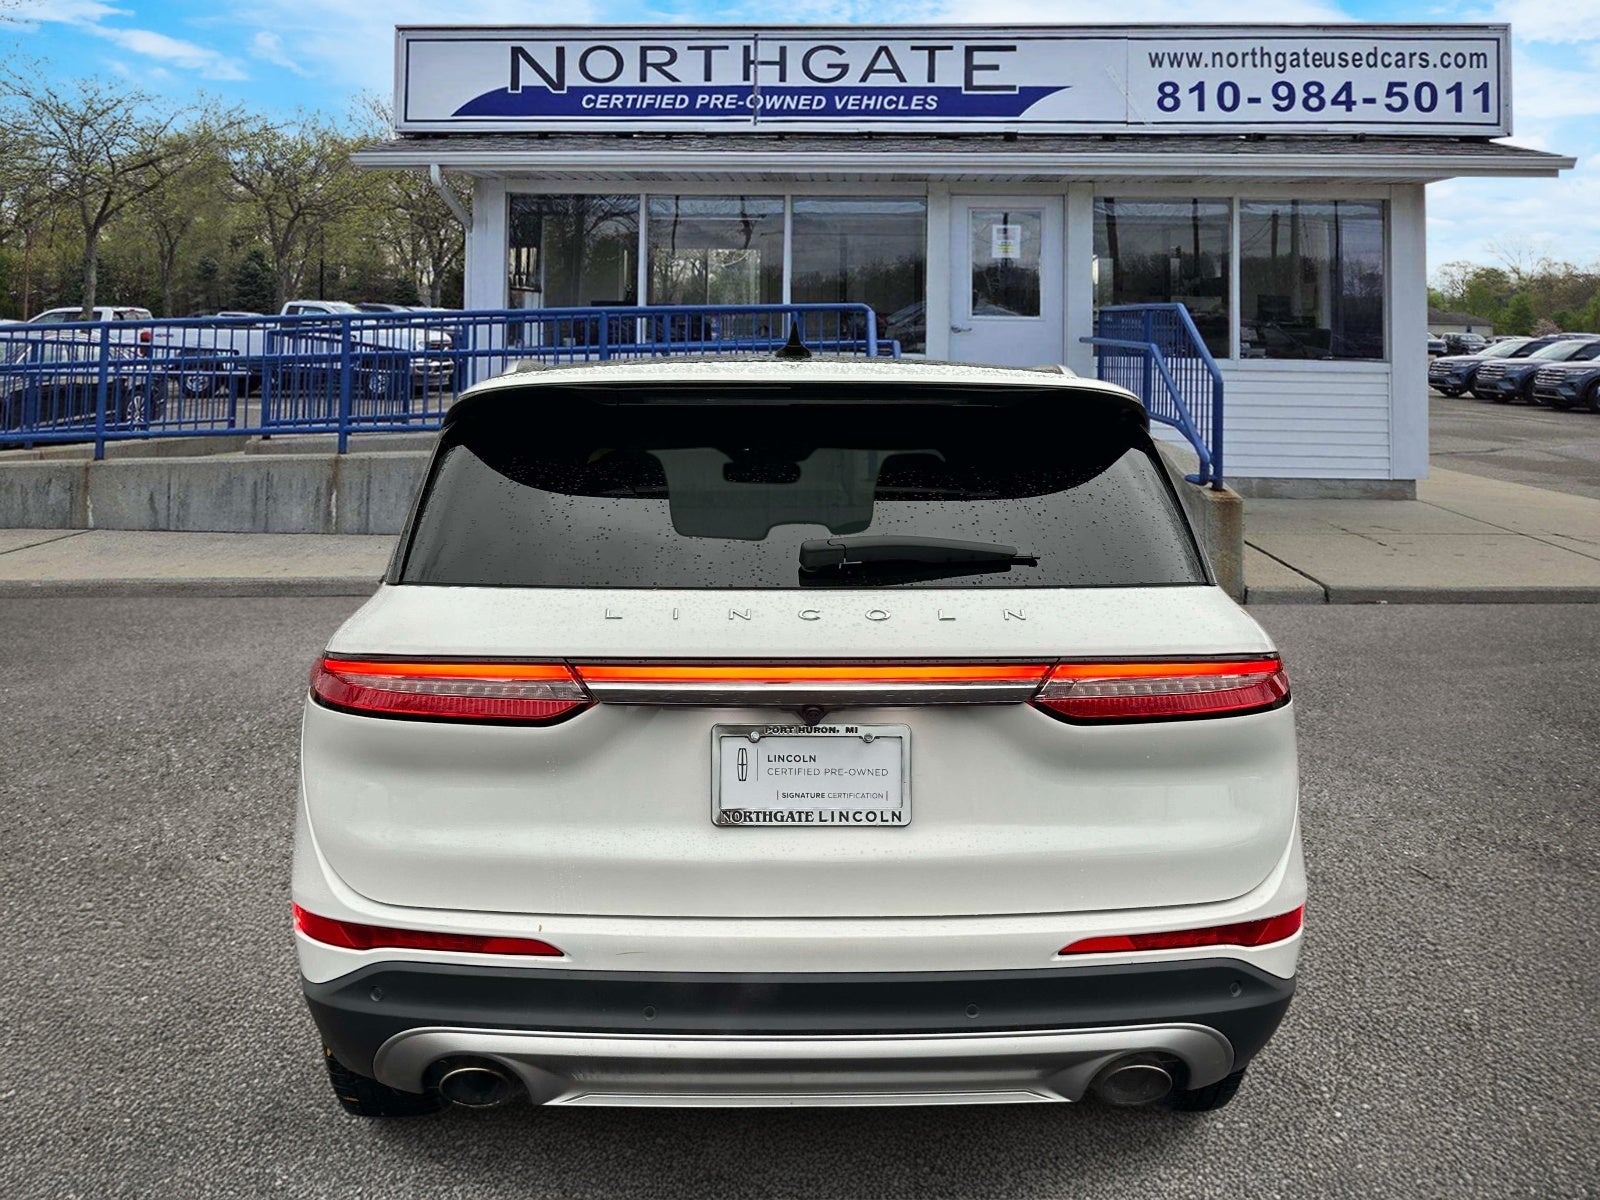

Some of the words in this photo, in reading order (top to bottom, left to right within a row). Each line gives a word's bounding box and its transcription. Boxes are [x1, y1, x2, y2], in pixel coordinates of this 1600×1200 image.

[1149, 47, 1488, 73] www.northgateusedcars.com
[510, 45, 1017, 93] NORTHGATE
[581, 94, 689, 109] CERTIFIED
[695, 94, 827, 110] PRE-OWNED
[834, 94, 938, 111] VEHICLES
[1156, 80, 1491, 113] 810-984-5011
[605, 608, 1027, 622] LINCOLN
[845, 726, 858, 734] MI
[767, 755, 817, 763] LINCOLN
[767, 767, 820, 776] CERTIFIED
[824, 768, 889, 777] PRE-OWNED
[827, 792, 884, 800] CERTIFICATION
[721, 810, 814, 823] NORTHGATE
[818, 811, 902, 823] LINCOLN
